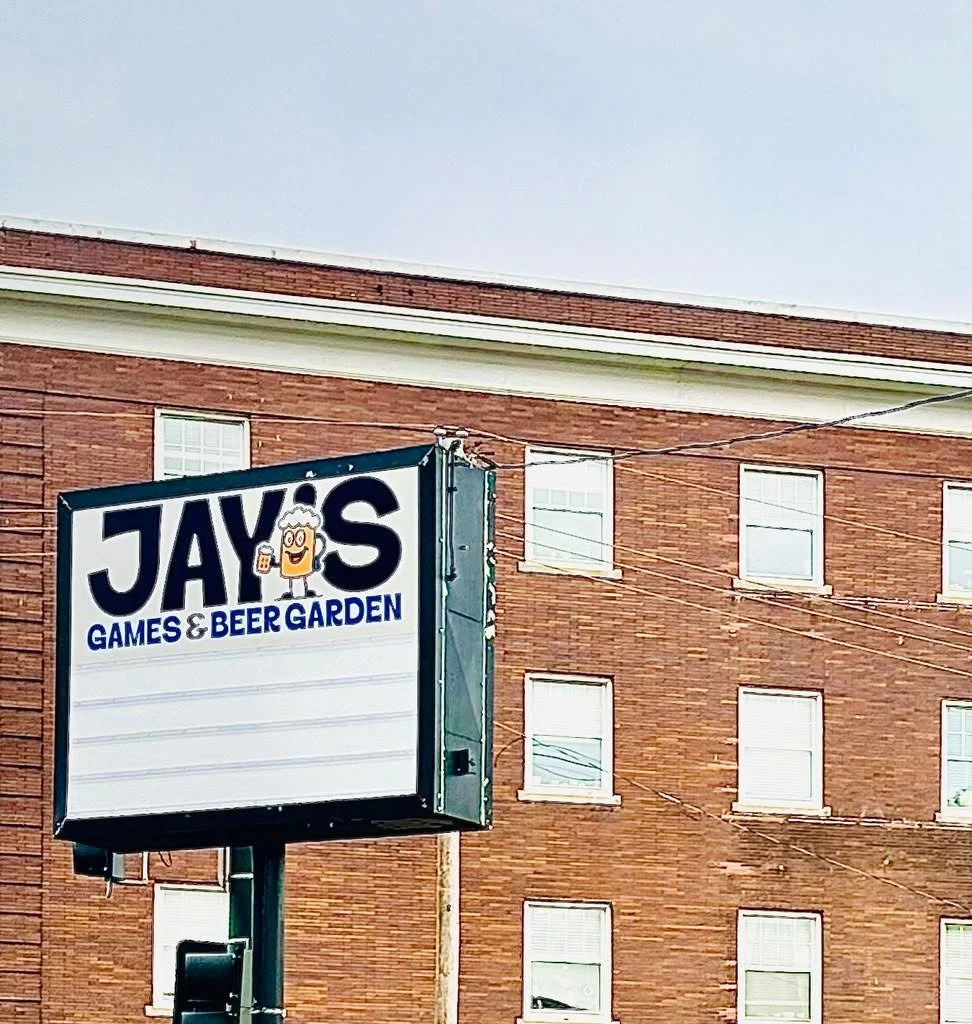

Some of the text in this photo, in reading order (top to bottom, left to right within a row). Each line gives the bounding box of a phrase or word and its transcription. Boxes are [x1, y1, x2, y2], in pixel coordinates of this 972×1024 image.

[87, 476, 402, 618] JAY'S
[87, 592, 402, 651] GAMES & BEER GARDEN
